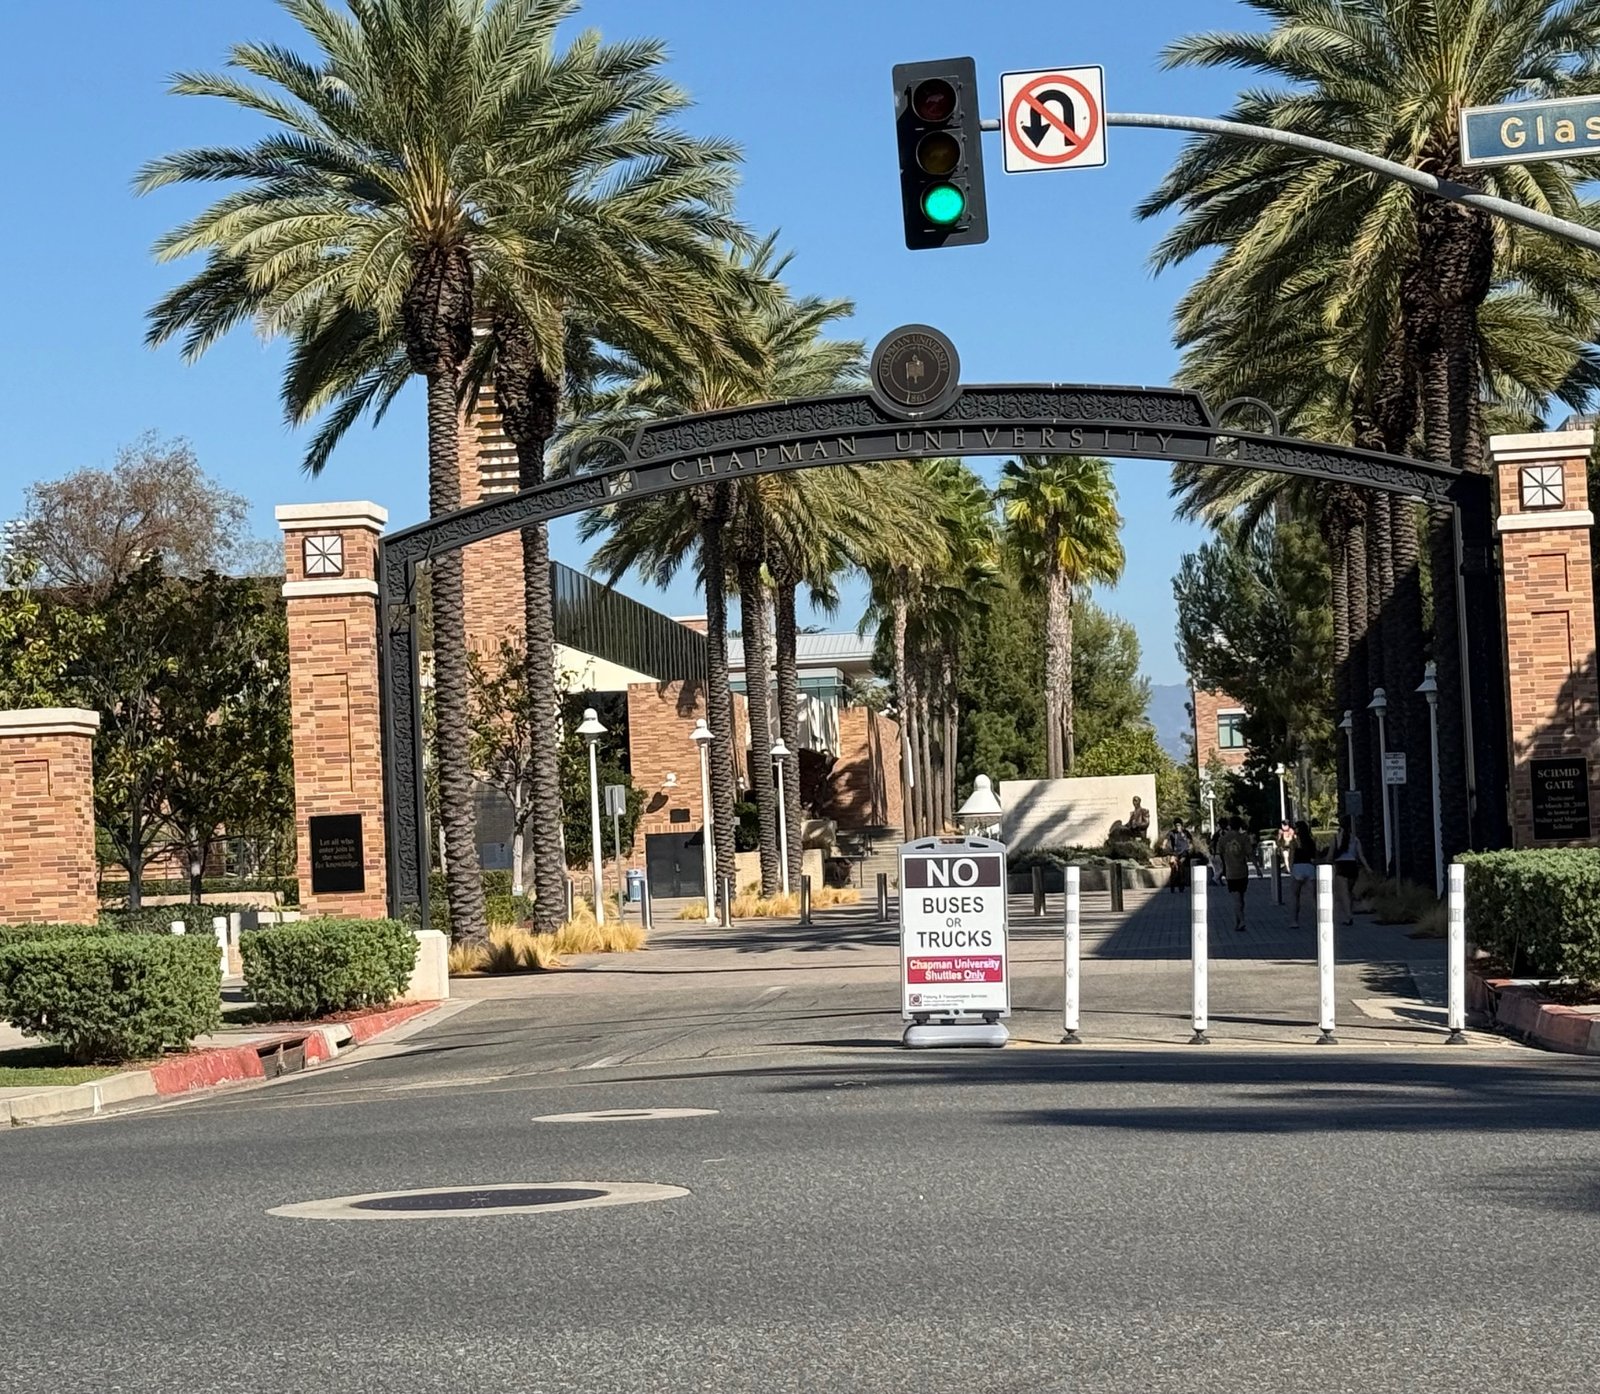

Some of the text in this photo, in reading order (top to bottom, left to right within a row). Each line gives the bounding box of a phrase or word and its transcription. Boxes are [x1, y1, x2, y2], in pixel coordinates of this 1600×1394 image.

[1501, 115, 1600, 148] Glas
[881, 335, 949, 377] CHAPMAN UNIVERSITY
[670, 427, 1173, 481] CHAPMAN UNIVERSITY
[1537, 768, 1580, 778] SCHMID
[1545, 780, 1574, 790] GATE
[926, 858, 979, 887] NO
[922, 896, 984, 914] BUSES
[946, 917, 962, 928] OR
[917, 930, 992, 948] TRUCKS
[910, 957, 1000, 971] Chapman University
[925, 969, 986, 981] Shuttles Only
